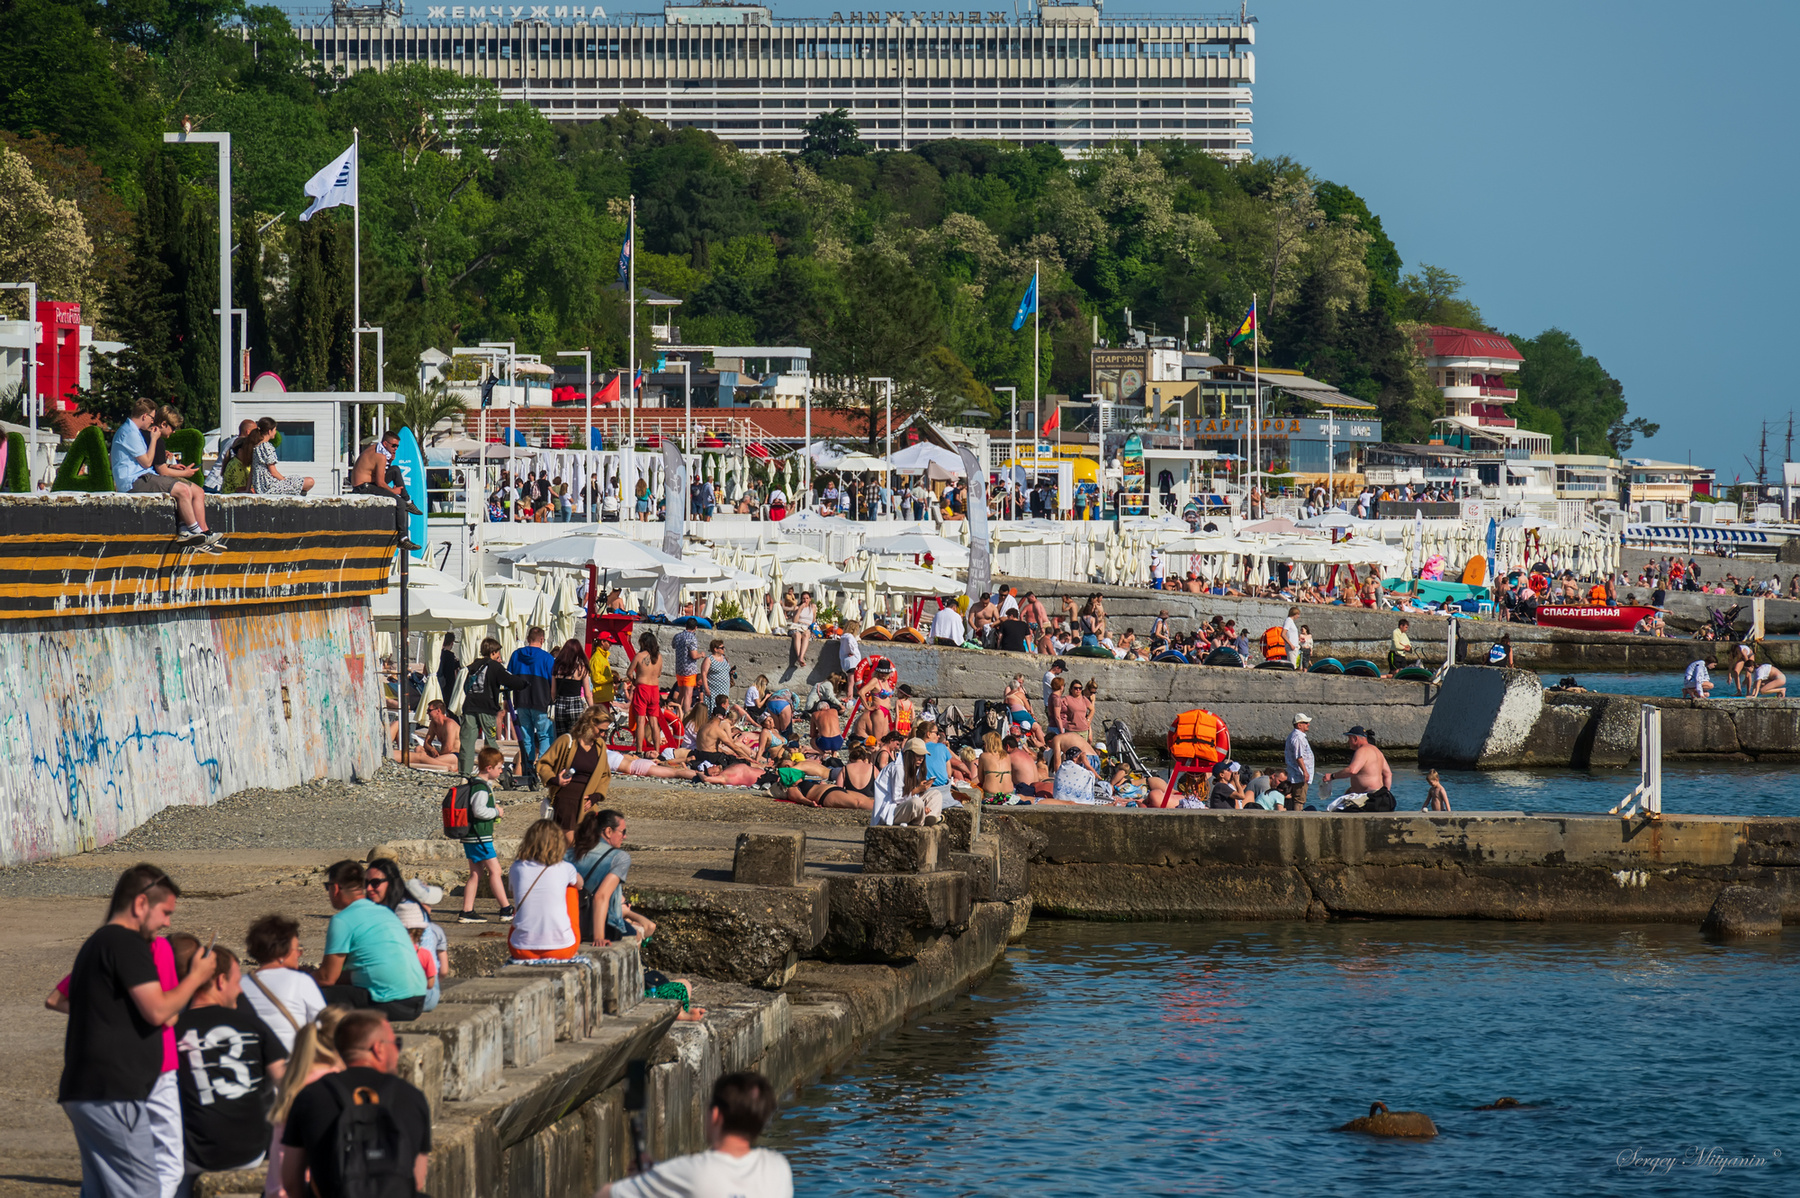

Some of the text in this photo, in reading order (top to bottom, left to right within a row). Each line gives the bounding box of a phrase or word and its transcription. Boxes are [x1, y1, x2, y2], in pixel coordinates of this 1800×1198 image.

[427, 5, 607, 19] ЖЕМЧУЖИНА
[1095, 355, 1144, 363] СТАРГОРОД
[1183, 419, 1301, 433] СТАРГОРОД
[1543, 608, 1620, 617] СПАСАТЕЛЬНАЯ
[177, 1025, 263, 1106] 13
